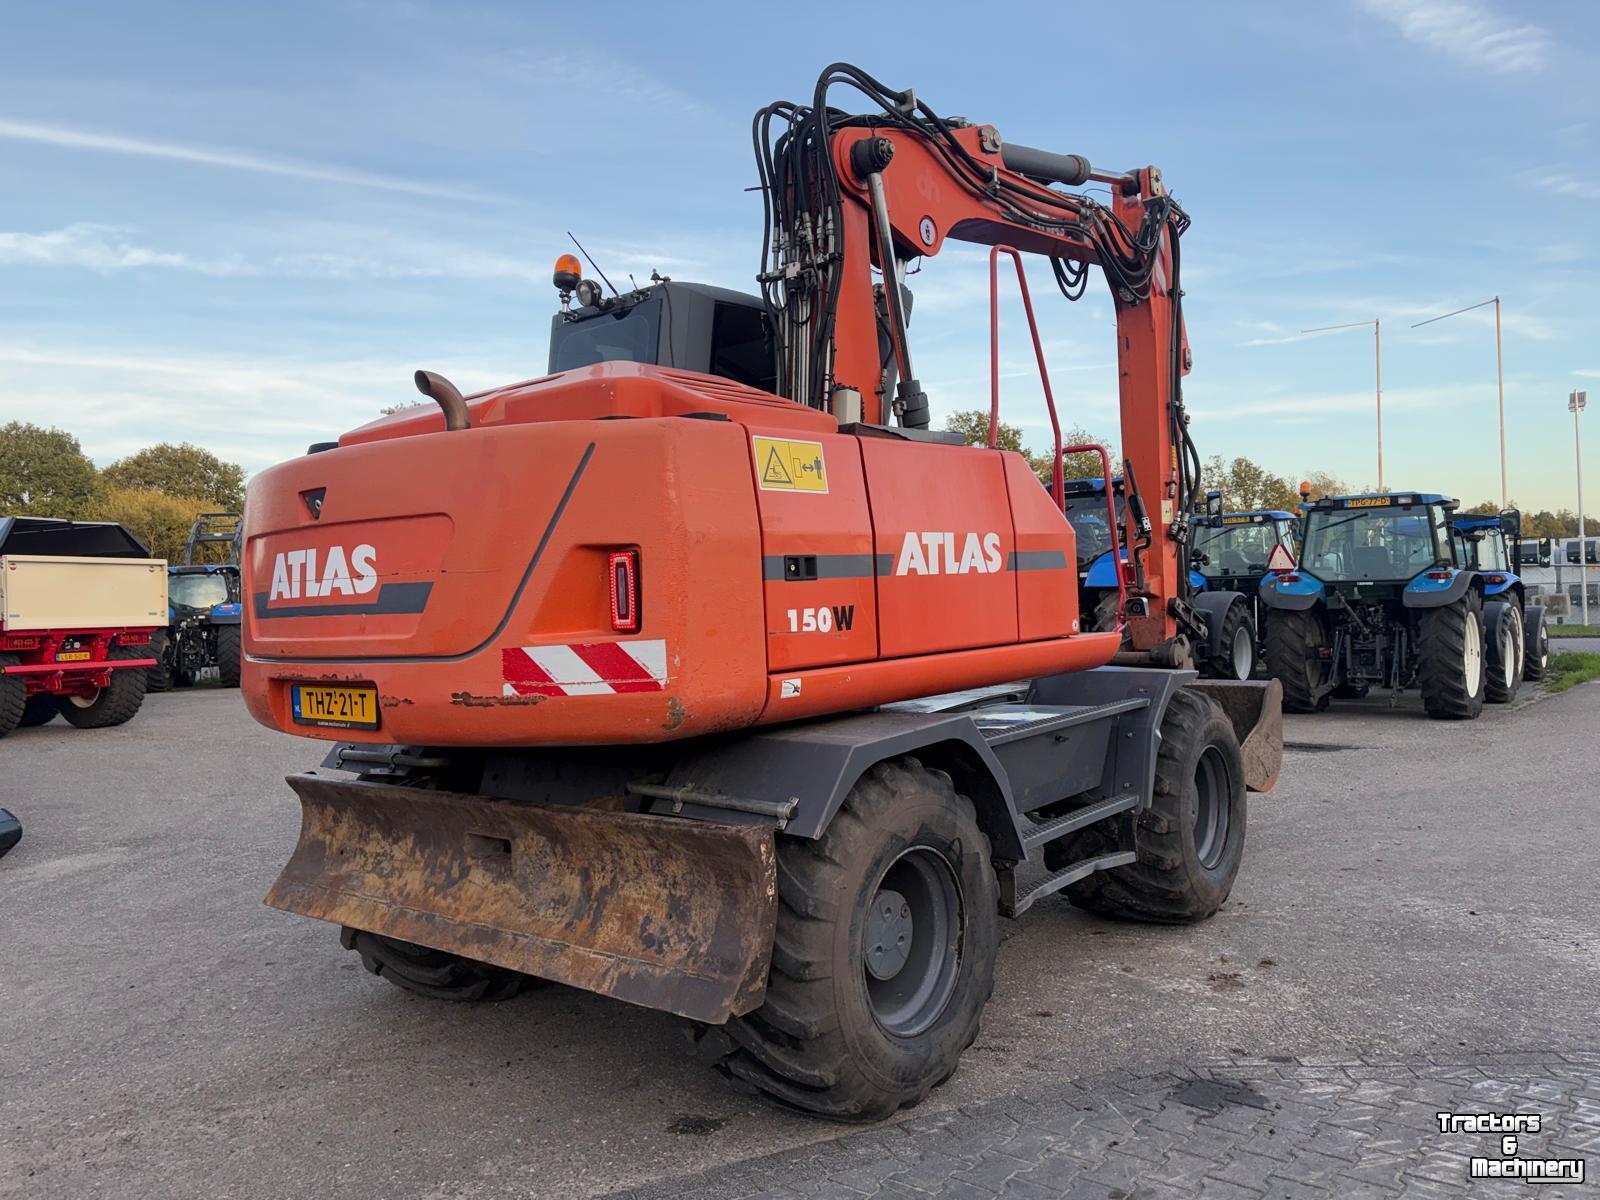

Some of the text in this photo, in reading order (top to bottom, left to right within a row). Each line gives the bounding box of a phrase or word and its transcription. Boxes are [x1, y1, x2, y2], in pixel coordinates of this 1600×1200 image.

[896, 532, 1001, 575] ATLAS
[270, 544, 377, 600] ATLAS
[787, 605, 854, 632] 150W
[306, 691, 367, 717] THZ-21-T
